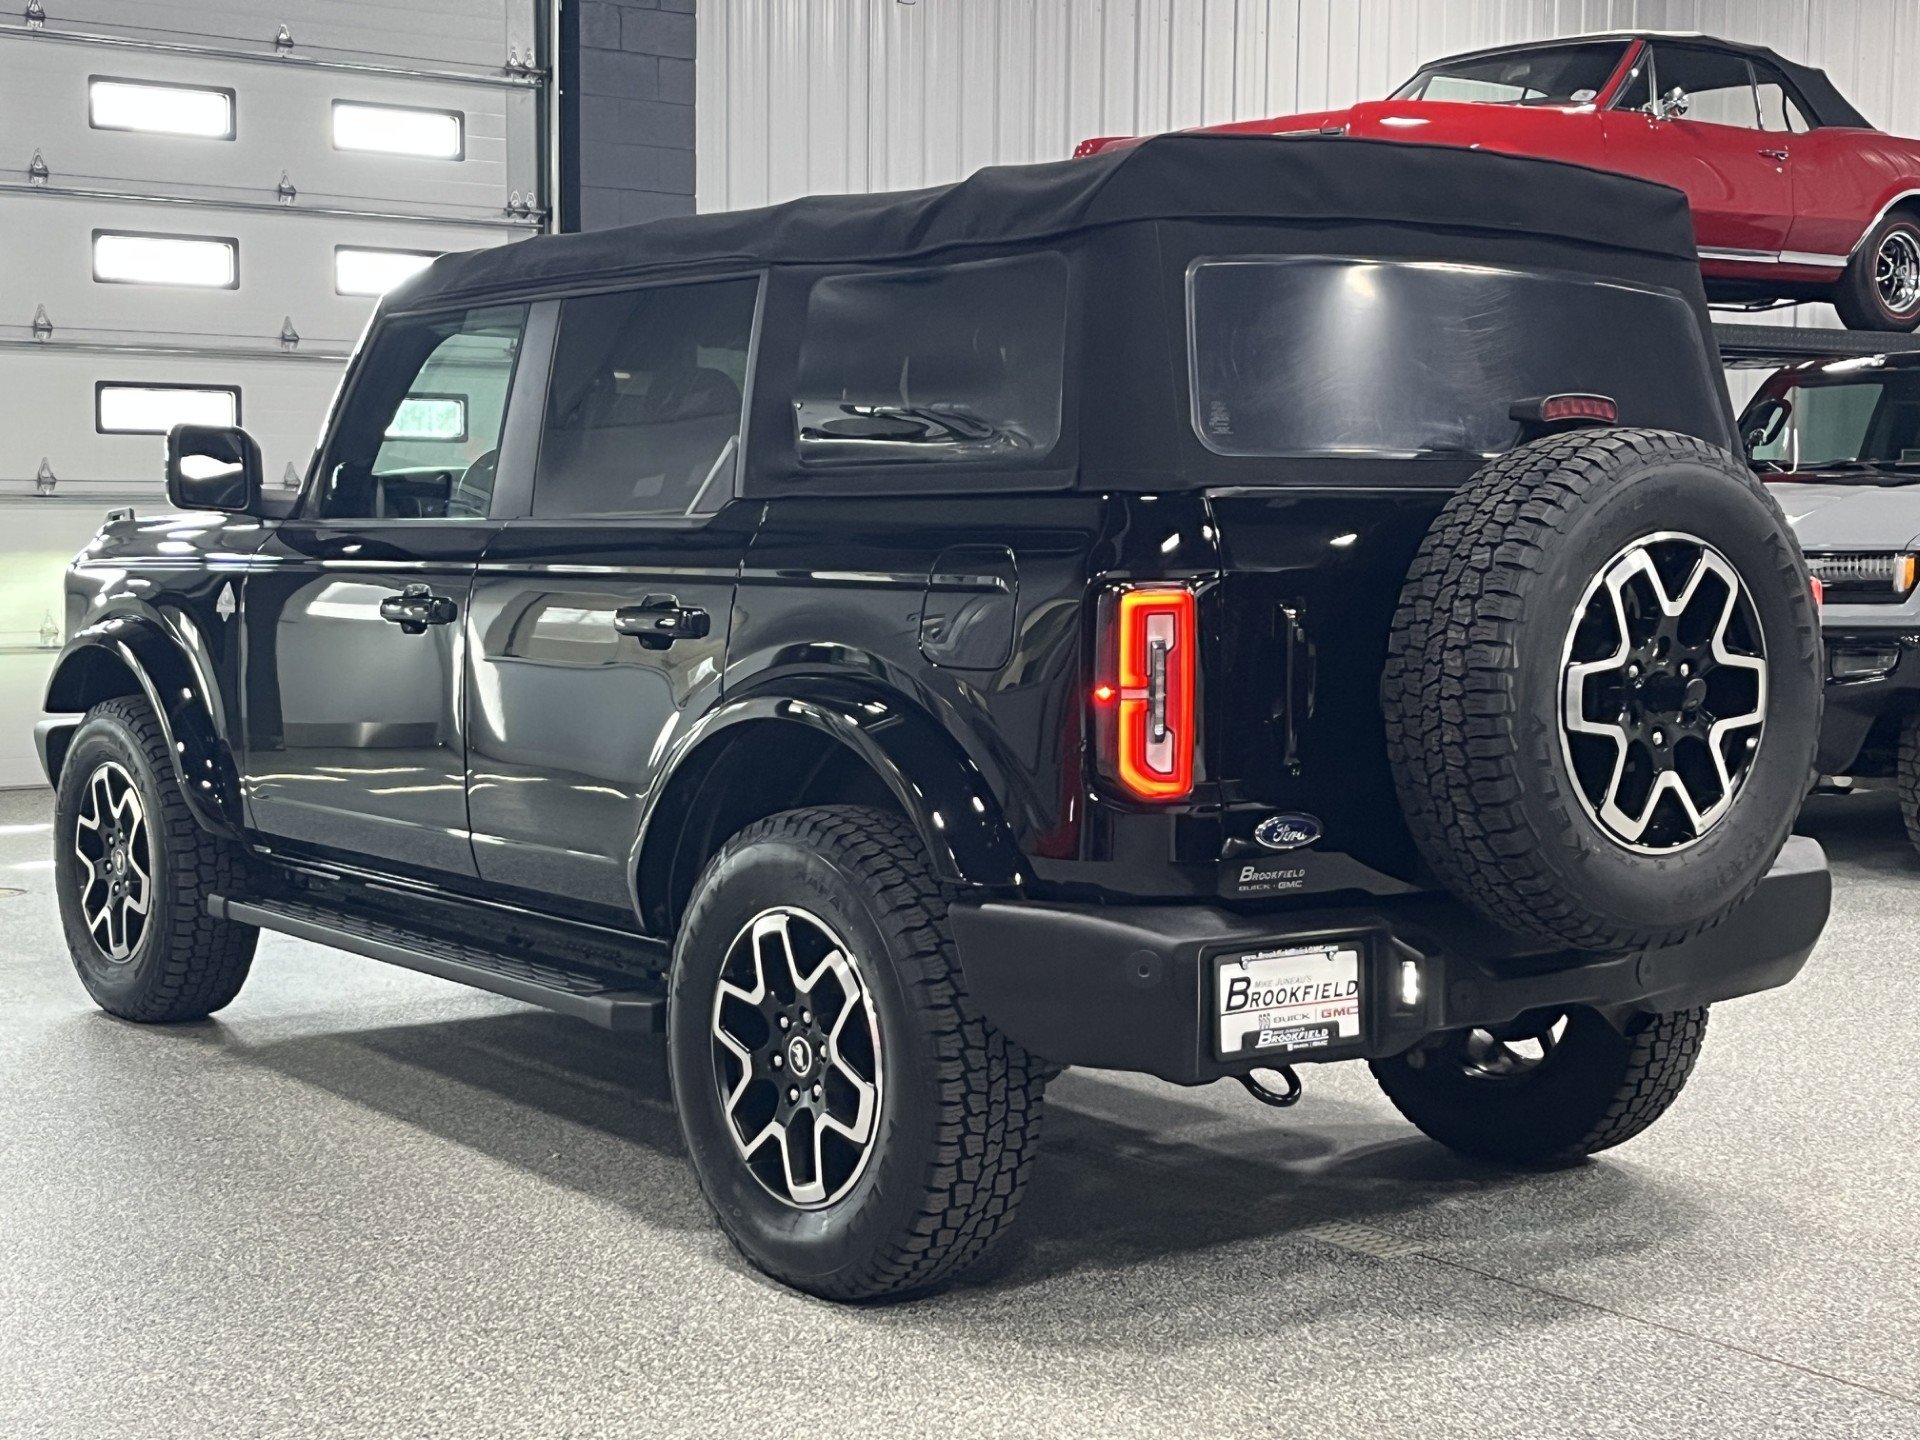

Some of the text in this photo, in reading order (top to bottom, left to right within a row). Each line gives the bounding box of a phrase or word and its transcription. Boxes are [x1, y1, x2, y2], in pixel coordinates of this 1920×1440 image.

[1272, 822, 1308, 842] Ford
[1239, 866, 1306, 882] BROOKFIELD
[1278, 880, 1303, 889] GMC
[1225, 976, 1359, 1012] BROOKFIELD
[1273, 1006, 1359, 1024] BUICK GMC
[1258, 1028, 1328, 1046] BROOKFIELD
